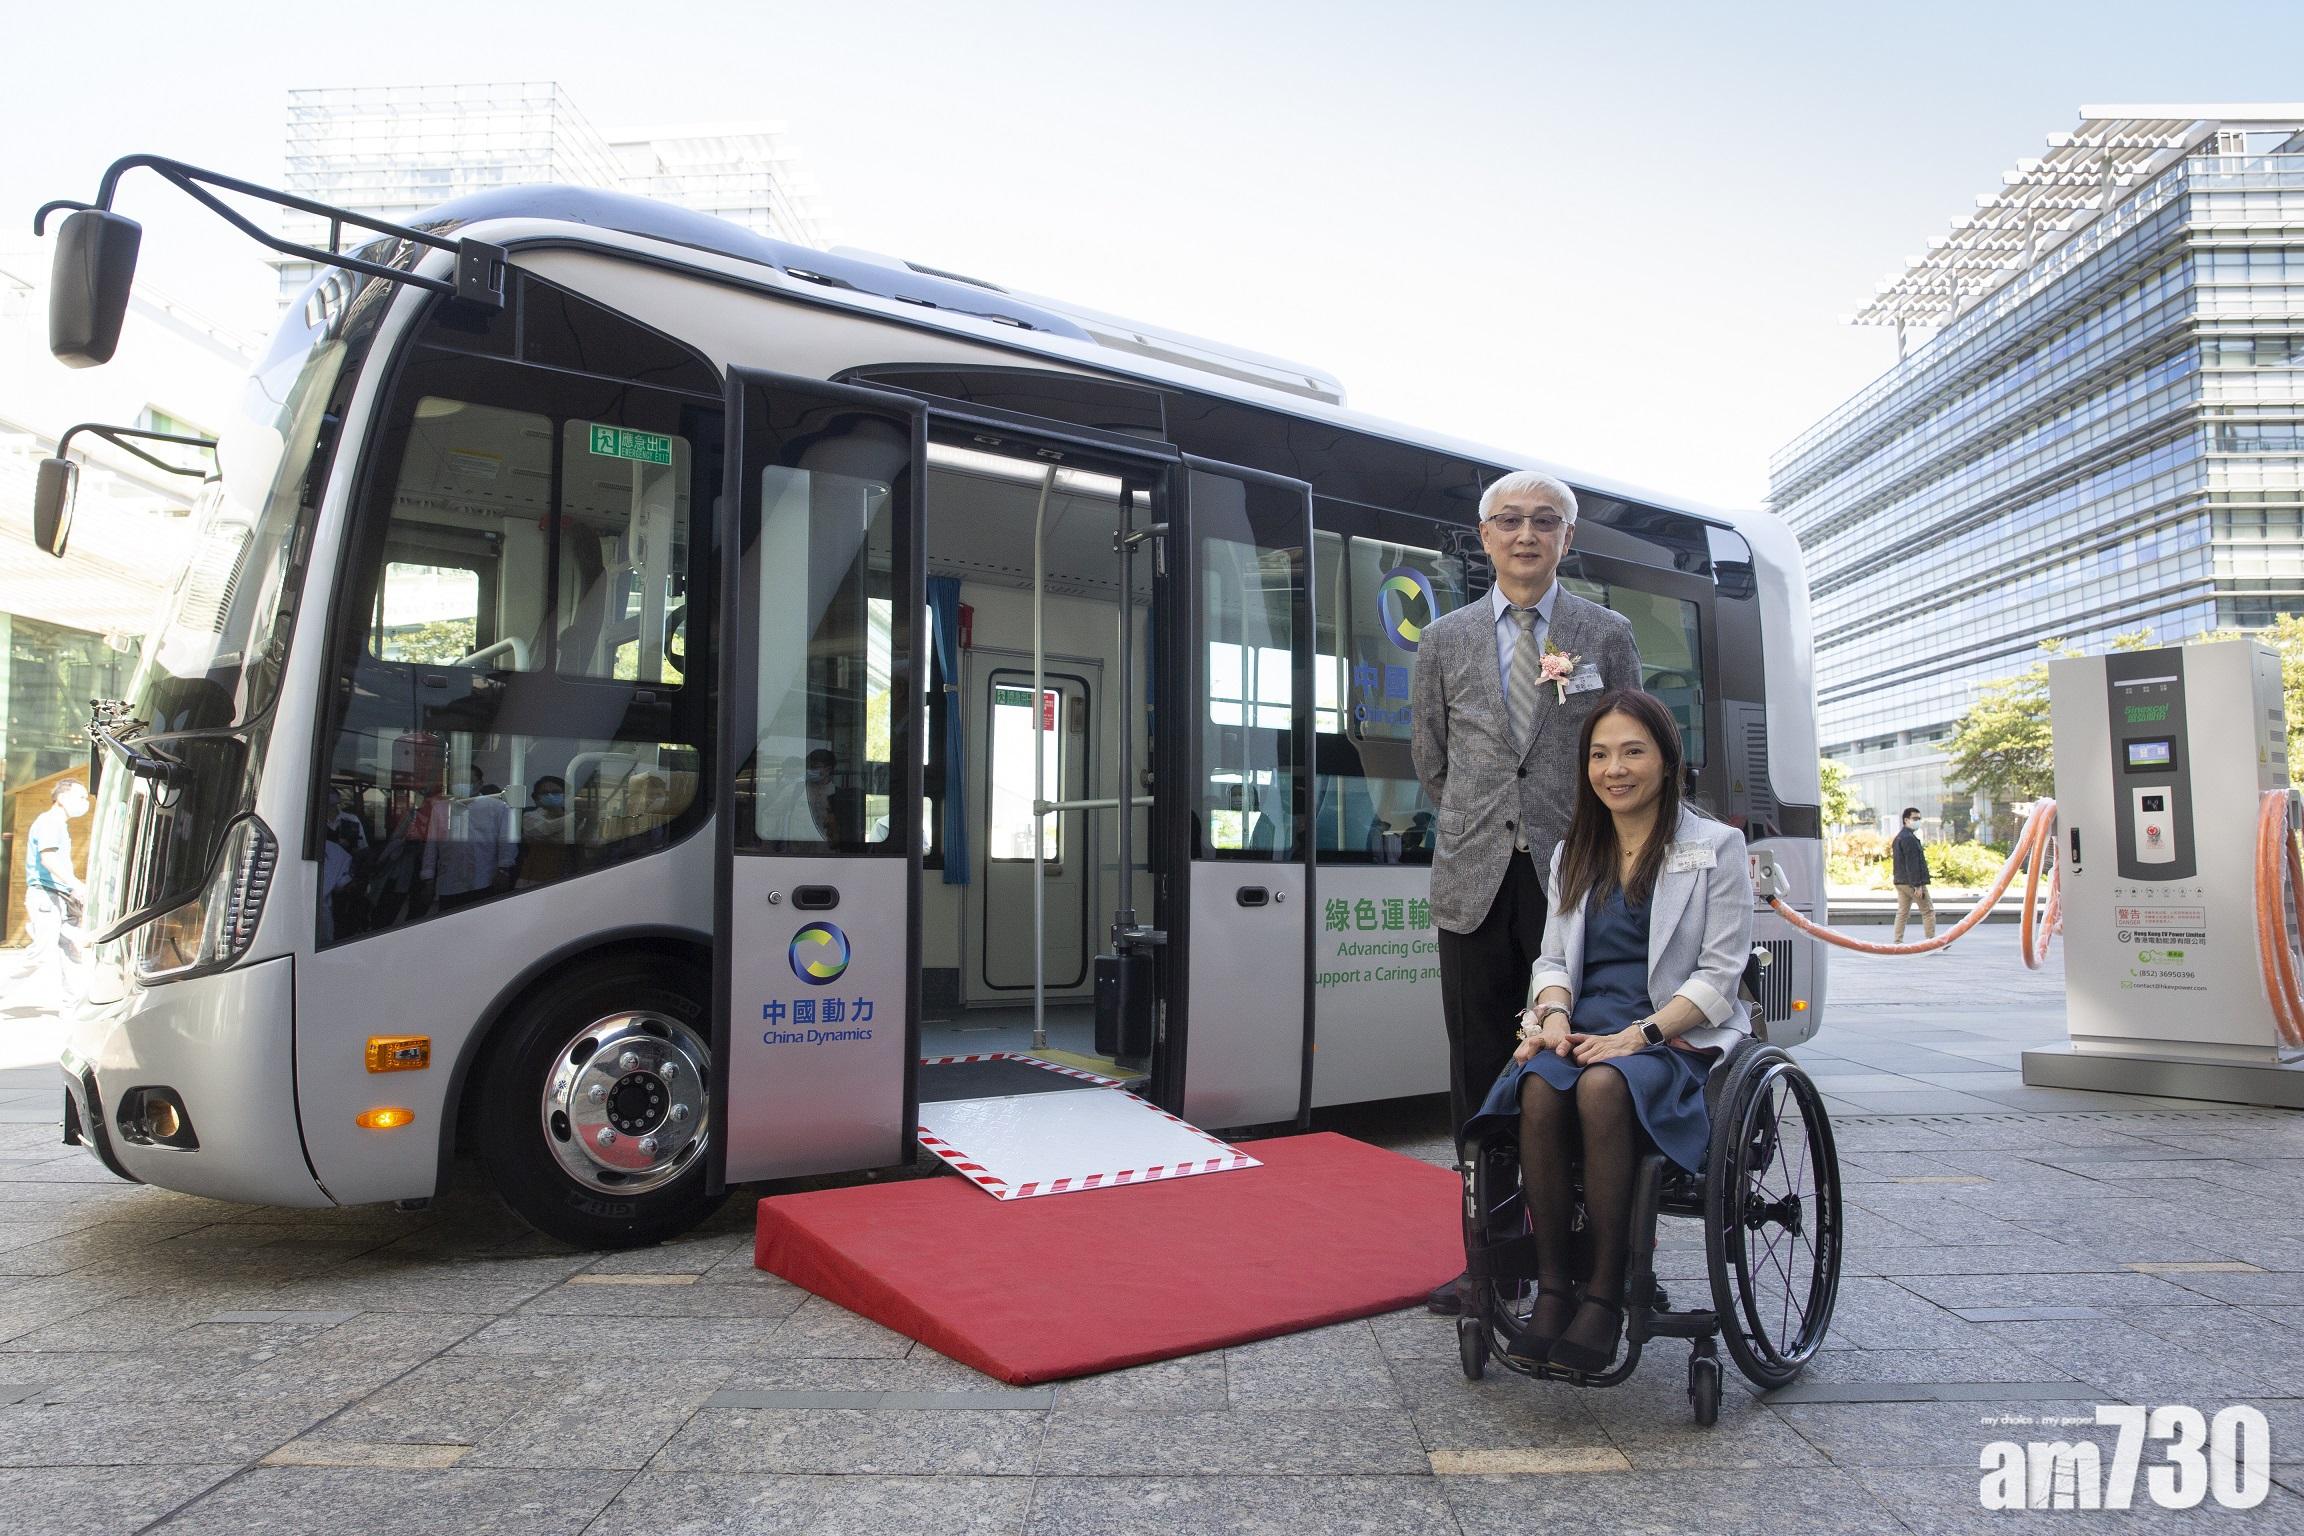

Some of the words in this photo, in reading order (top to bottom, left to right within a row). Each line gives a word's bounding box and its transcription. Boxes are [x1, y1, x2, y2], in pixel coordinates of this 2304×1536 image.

[622, 432, 669, 453] 應急出口
[621, 448, 654, 460] EMERGENCY
[655, 453, 669, 462] EXIT
[1325, 898, 1431, 932] 綠色運輸
[2118, 908, 2141, 919] 警告
[1337, 940, 1409, 958] Advancing
[1364, 972, 1372, 981] a
[1375, 966, 1417, 983] Caring
[763, 996, 875, 1025] 中國動力
[763, 1031, 803, 1044] China
[807, 1028, 872, 1046] Dynamics
